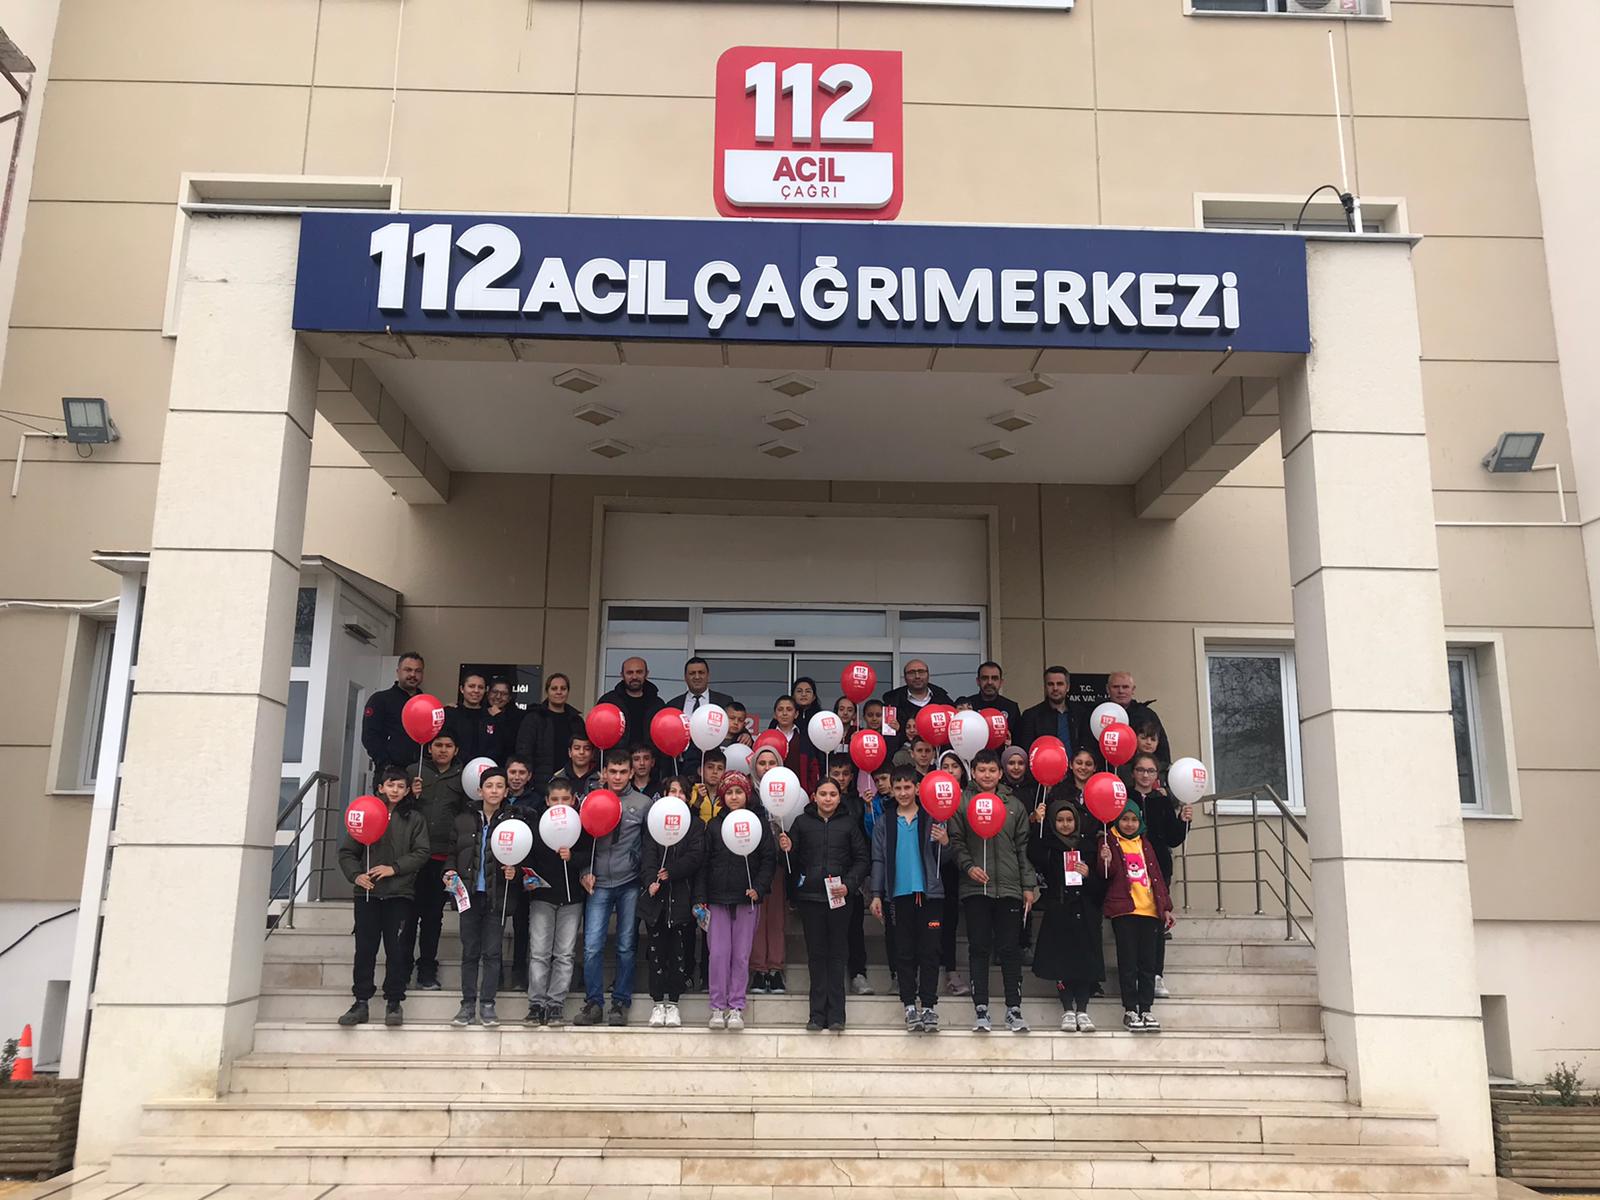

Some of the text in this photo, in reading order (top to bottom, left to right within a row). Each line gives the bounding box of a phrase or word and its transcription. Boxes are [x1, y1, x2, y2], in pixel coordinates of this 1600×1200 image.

[745, 62, 874, 143] 112
[781, 184, 837, 200] ÇAĞRI
[369, 223, 521, 313] 112
[1079, 684, 1094, 692] T.C.
[771, 783, 784, 791] 112
[938, 783, 950, 791] 112
[979, 800, 990, 808] 112
[350, 812, 362, 821] 112
[667, 816, 679, 825] 112
[736, 823, 749, 832] 112
